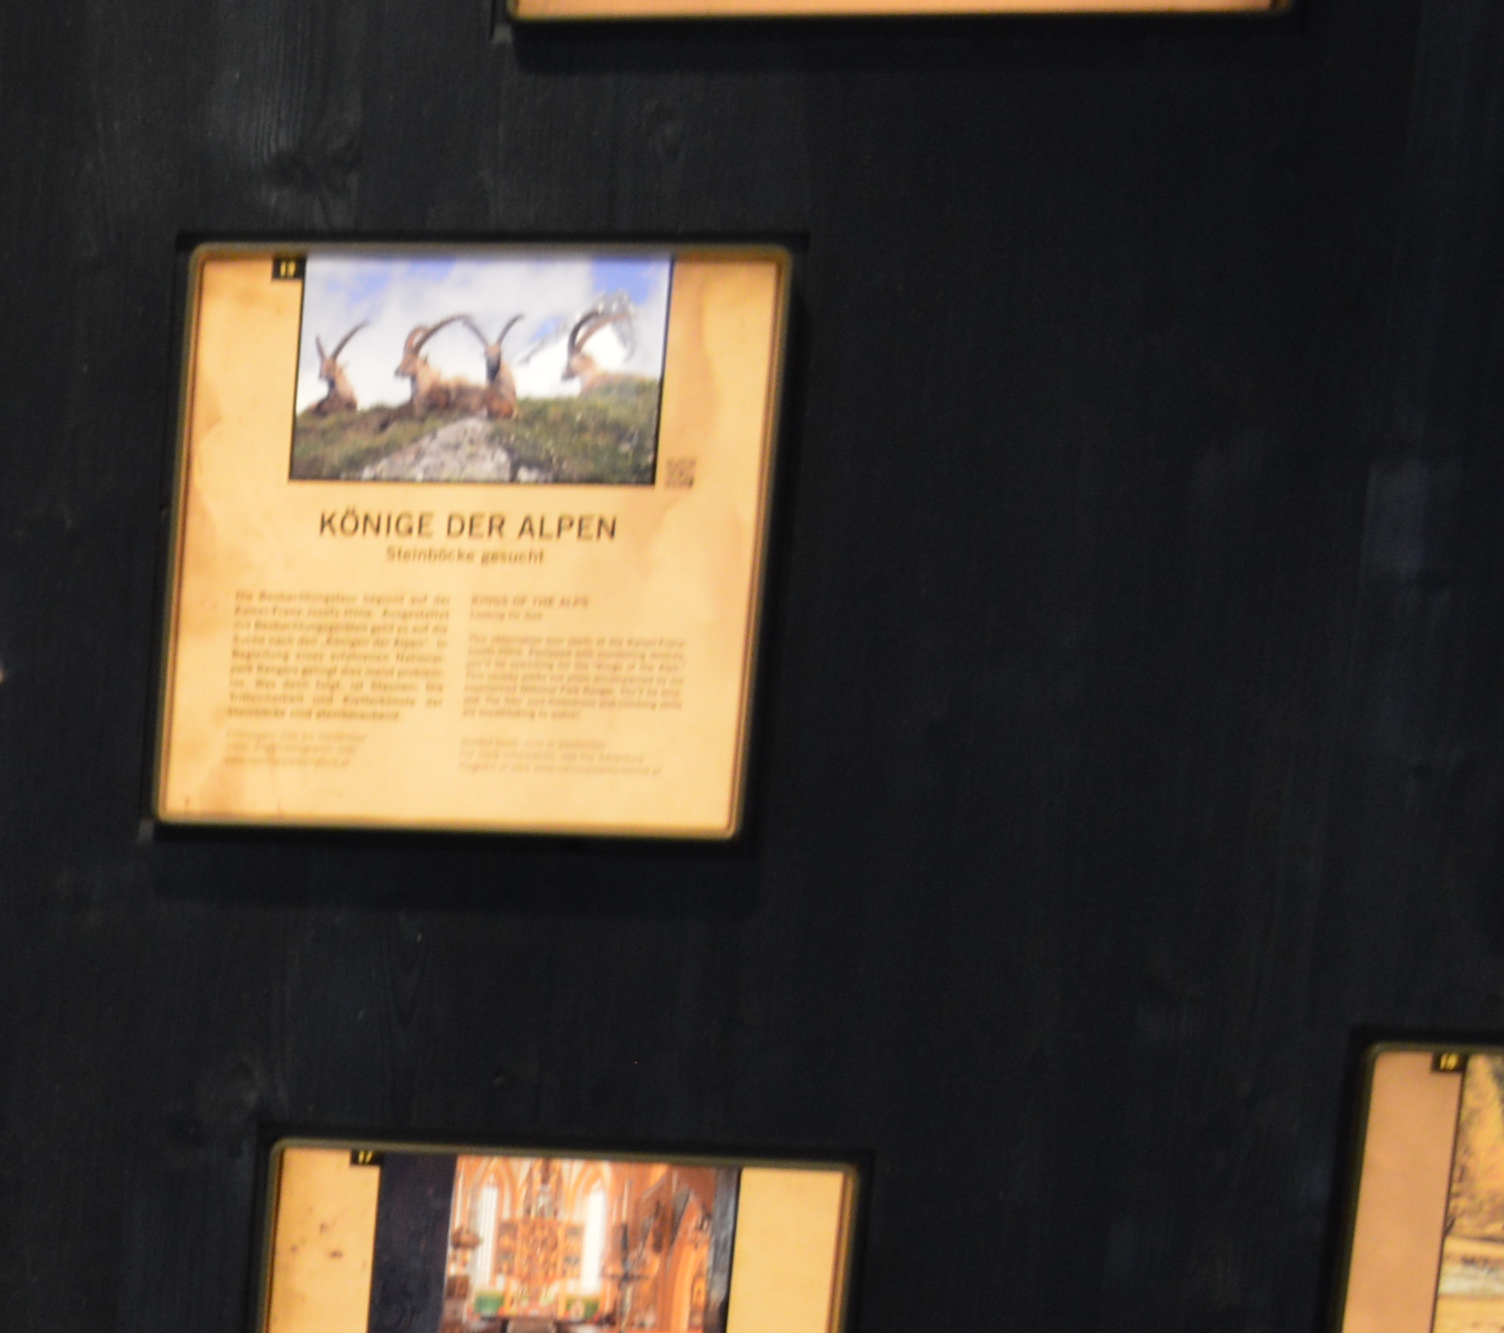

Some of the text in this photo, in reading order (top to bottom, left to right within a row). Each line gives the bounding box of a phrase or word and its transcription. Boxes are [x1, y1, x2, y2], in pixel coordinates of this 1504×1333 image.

[319, 507, 619, 543] KÖNIGE DER ALPEN
[386, 545, 546, 568] Steinböcke gesucht
